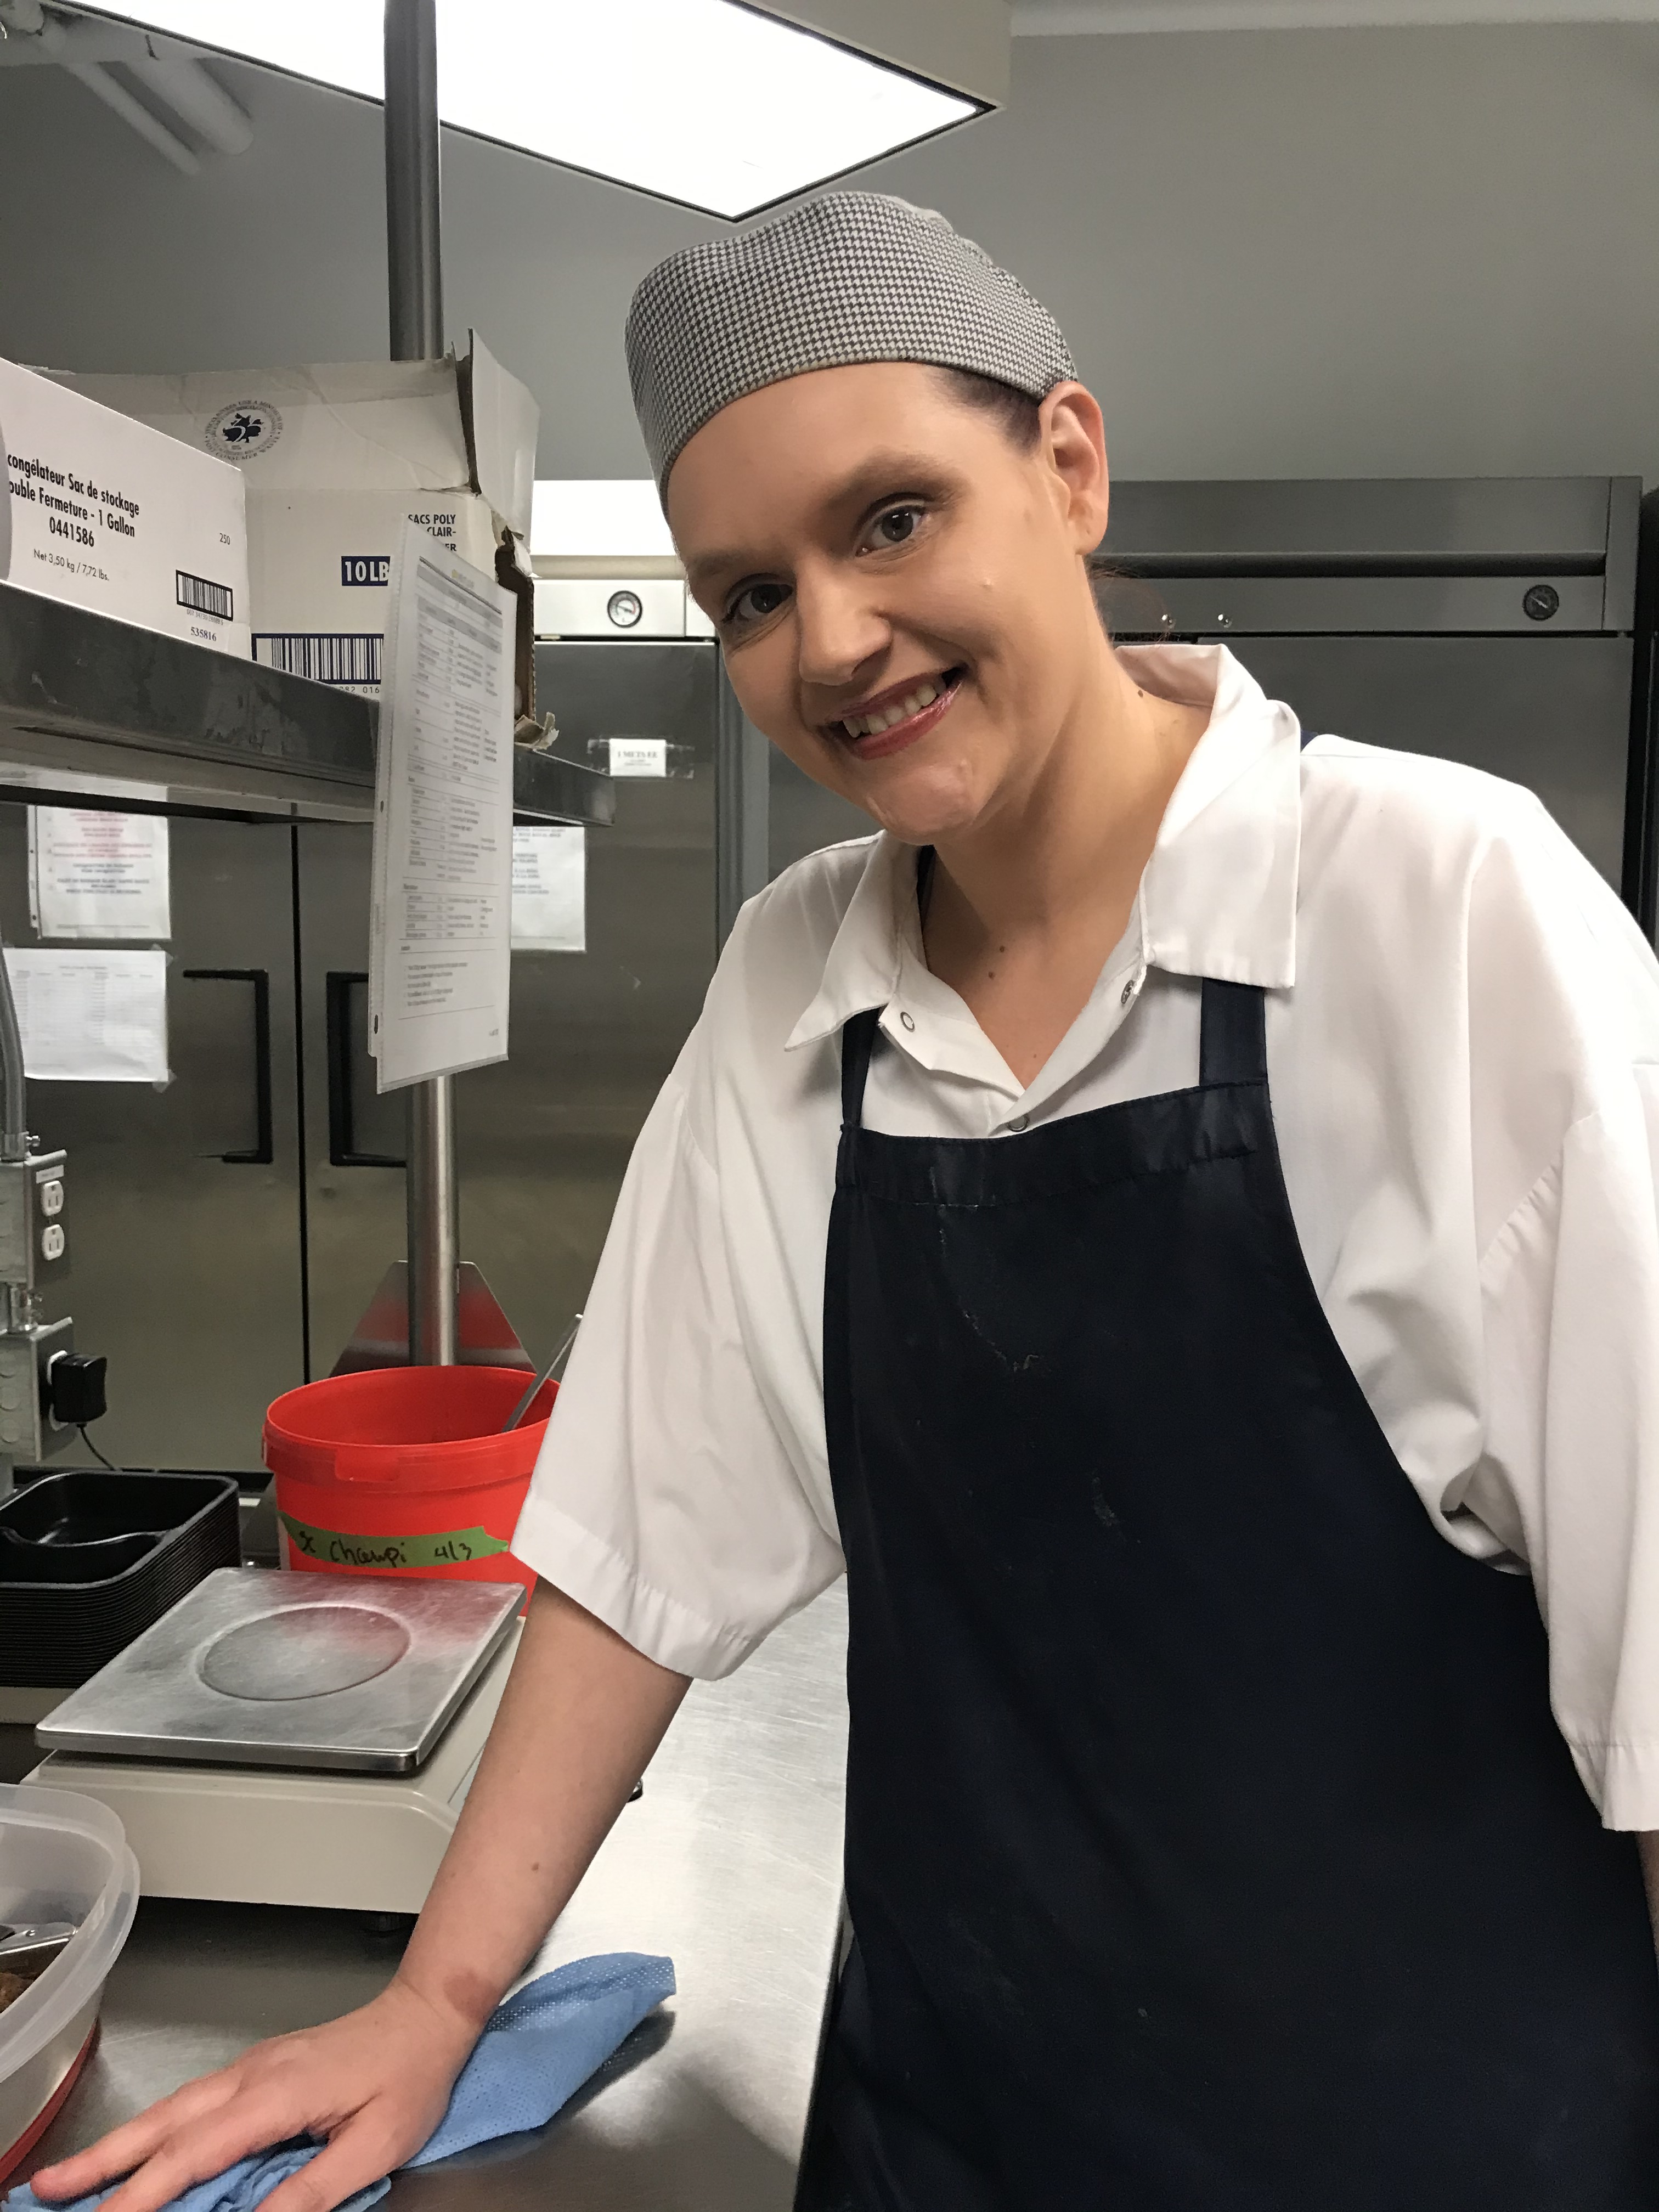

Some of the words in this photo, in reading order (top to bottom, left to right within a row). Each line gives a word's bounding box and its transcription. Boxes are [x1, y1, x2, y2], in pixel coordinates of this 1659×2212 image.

[7, 454, 65, 487] congélateur
[68, 473, 84, 494] Sac
[87, 480, 98, 500] de
[101, 491, 140, 518] stockage
[39, 487, 88, 520] Fermeture
[98, 509, 103, 526] 1
[107, 513, 136, 537] Gallon
[408, 514, 431, 524] SACS
[433, 514, 456, 524] POLY
[49, 516, 94, 548] 0441586
[219, 533, 231, 545] 250
[33, 548, 47, 561] Net
[66, 558, 75, 573] kg
[190, 626, 217, 642] 535816
